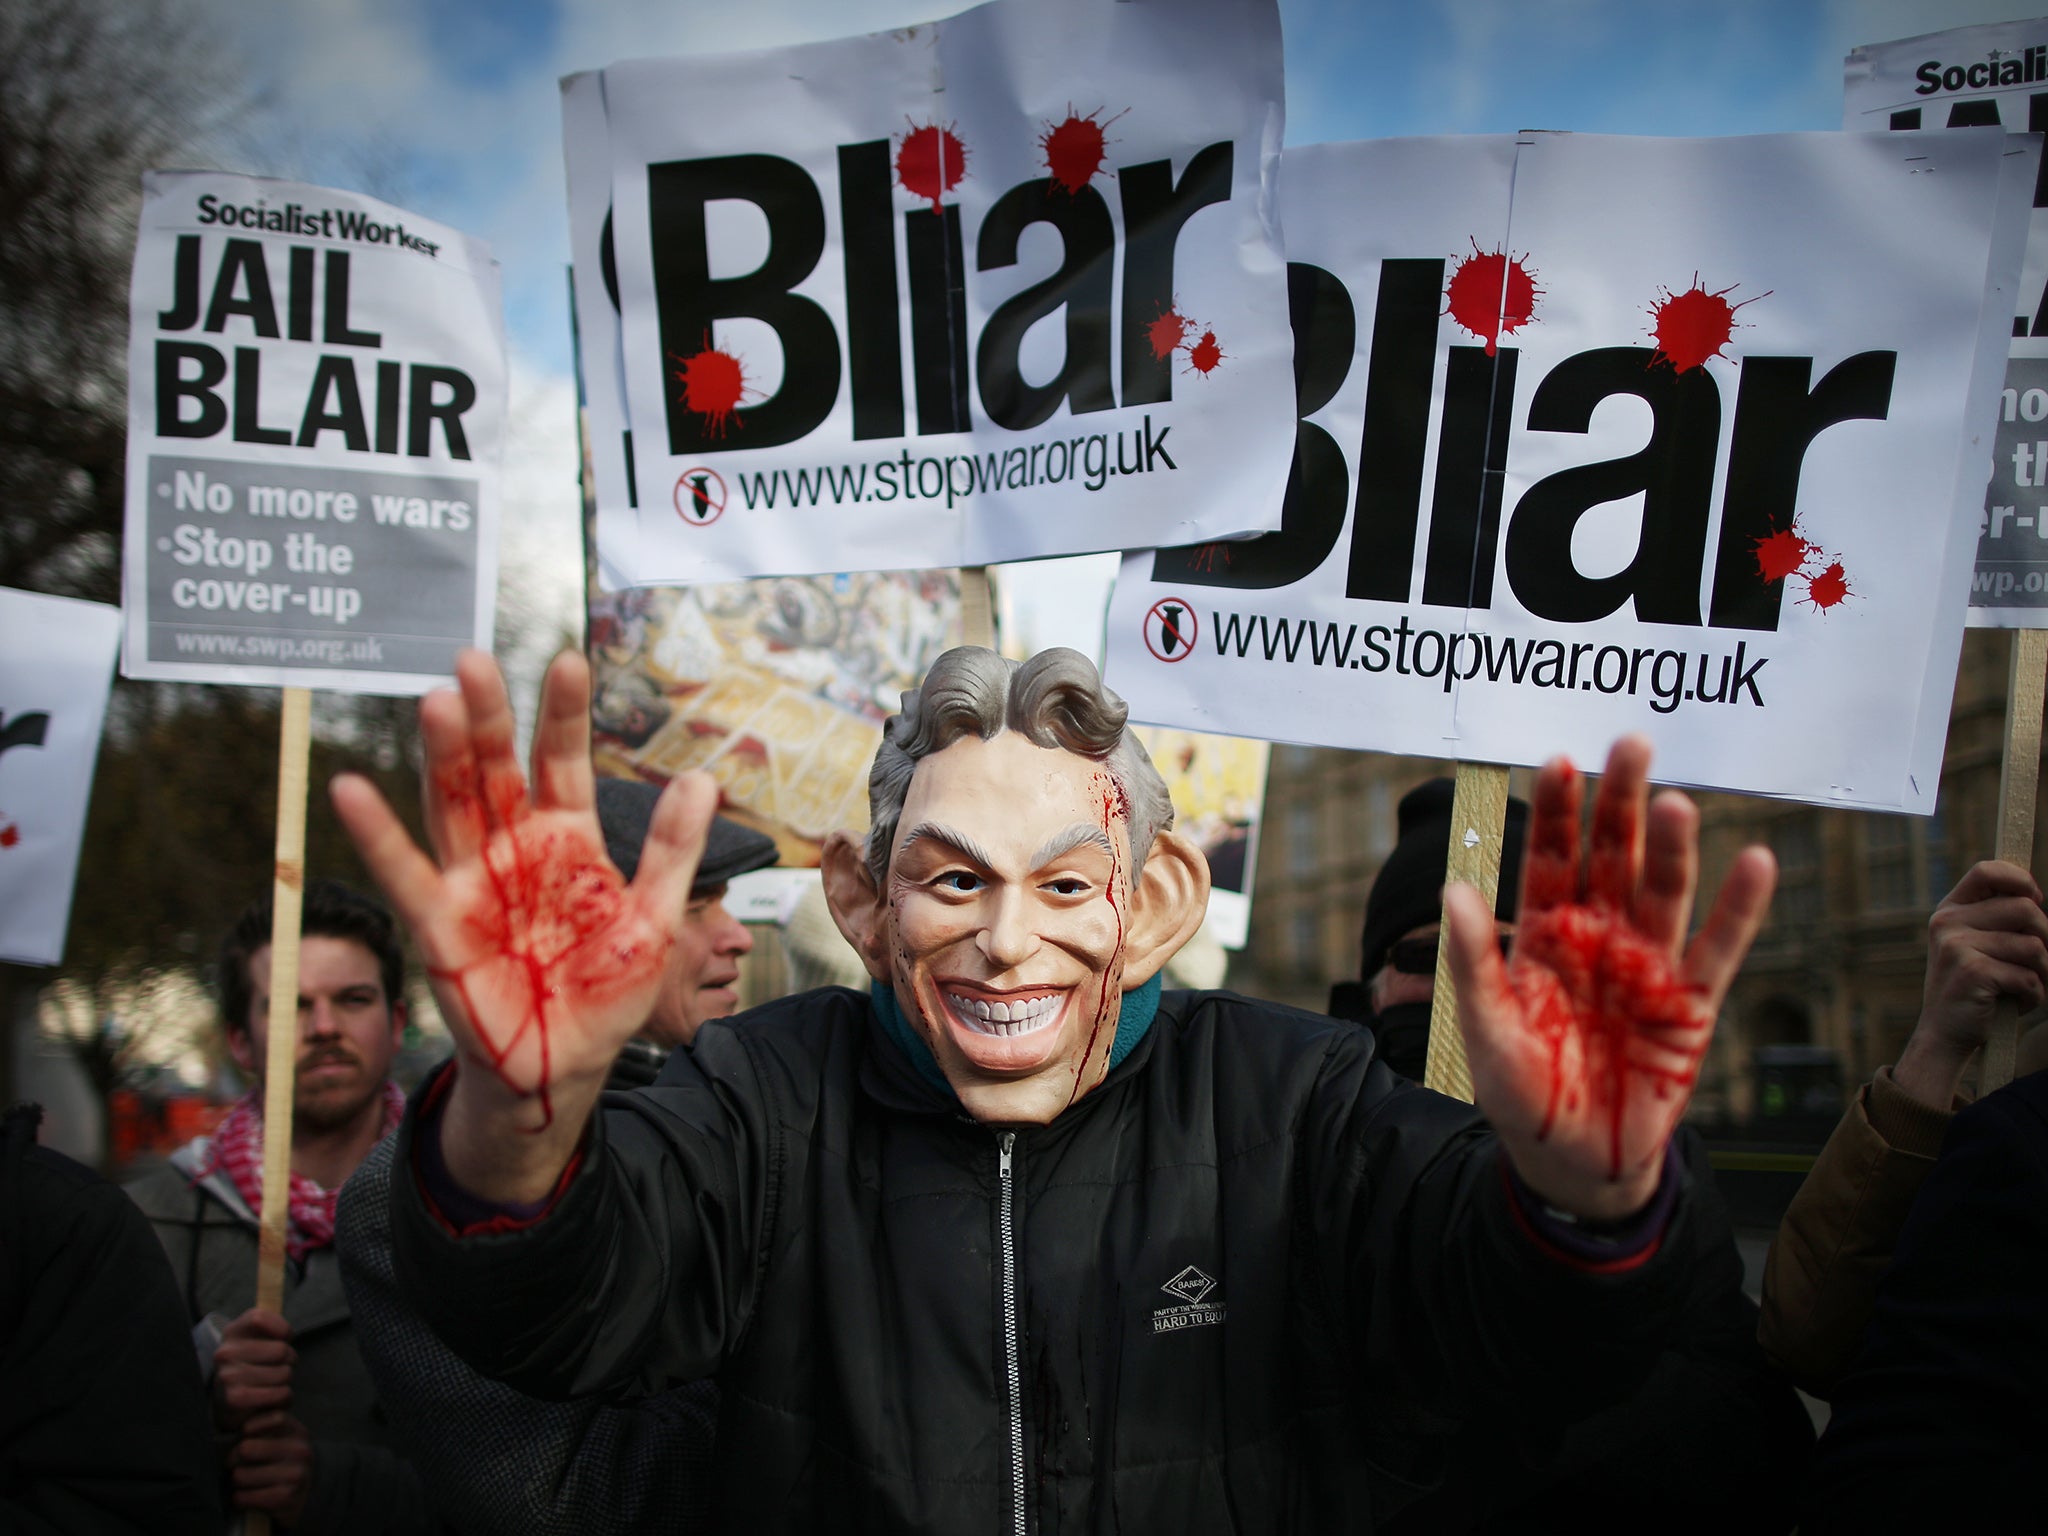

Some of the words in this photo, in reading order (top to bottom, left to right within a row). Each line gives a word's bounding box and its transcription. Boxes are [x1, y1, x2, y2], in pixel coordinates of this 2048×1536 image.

[1915, 45, 2048, 95] Sociali
[158, 234, 382, 349] JAIL
[647, 128, 1234, 455] Bliar
[155, 339, 477, 461] BLAIR
[739, 415, 1177, 510] www.stopwar.org.uk
[248, 484, 358, 524] more
[372, 492, 471, 532] wars
[172, 524, 272, 577] Stop
[284, 532, 353, 574] the
[172, 577, 361, 623] cover-up
[176, 630, 382, 664] www.swp.org.uk
[1213, 611, 1769, 714] www.stopwar.org.uk
[1153, 1315, 1187, 1331] HARD
[1189, 1313, 1203, 1324] TO
